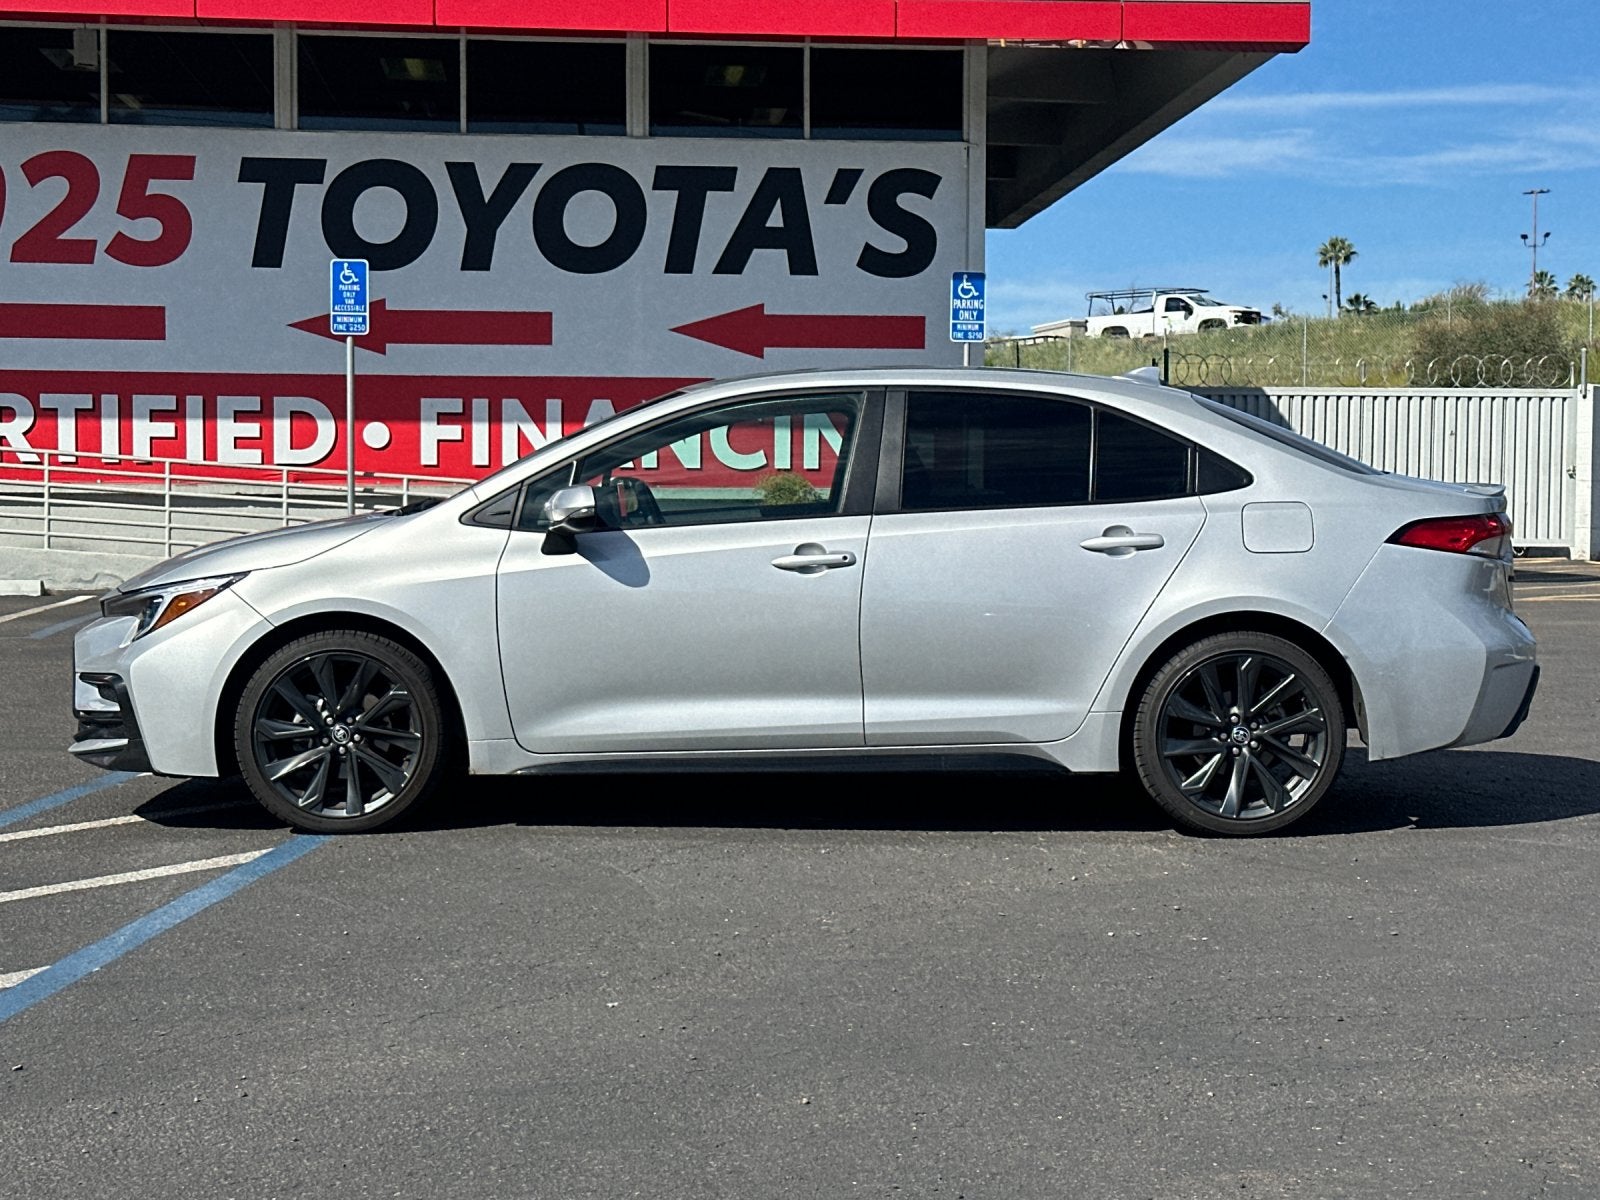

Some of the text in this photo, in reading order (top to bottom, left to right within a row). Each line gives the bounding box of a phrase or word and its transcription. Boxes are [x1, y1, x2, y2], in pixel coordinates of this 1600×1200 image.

[0, 150, 943, 278] 25 TOYOTA'S
[334, 304, 365, 312] ACCESSIBLE
[953, 298, 984, 310] PARKING
[958, 310, 978, 320] ONLY
[333, 323, 347, 331] FINE
[956, 323, 979, 331] MINIMUM
[953, 331, 983, 339] FINE $250
[419, 397, 845, 471] FINNCIN
